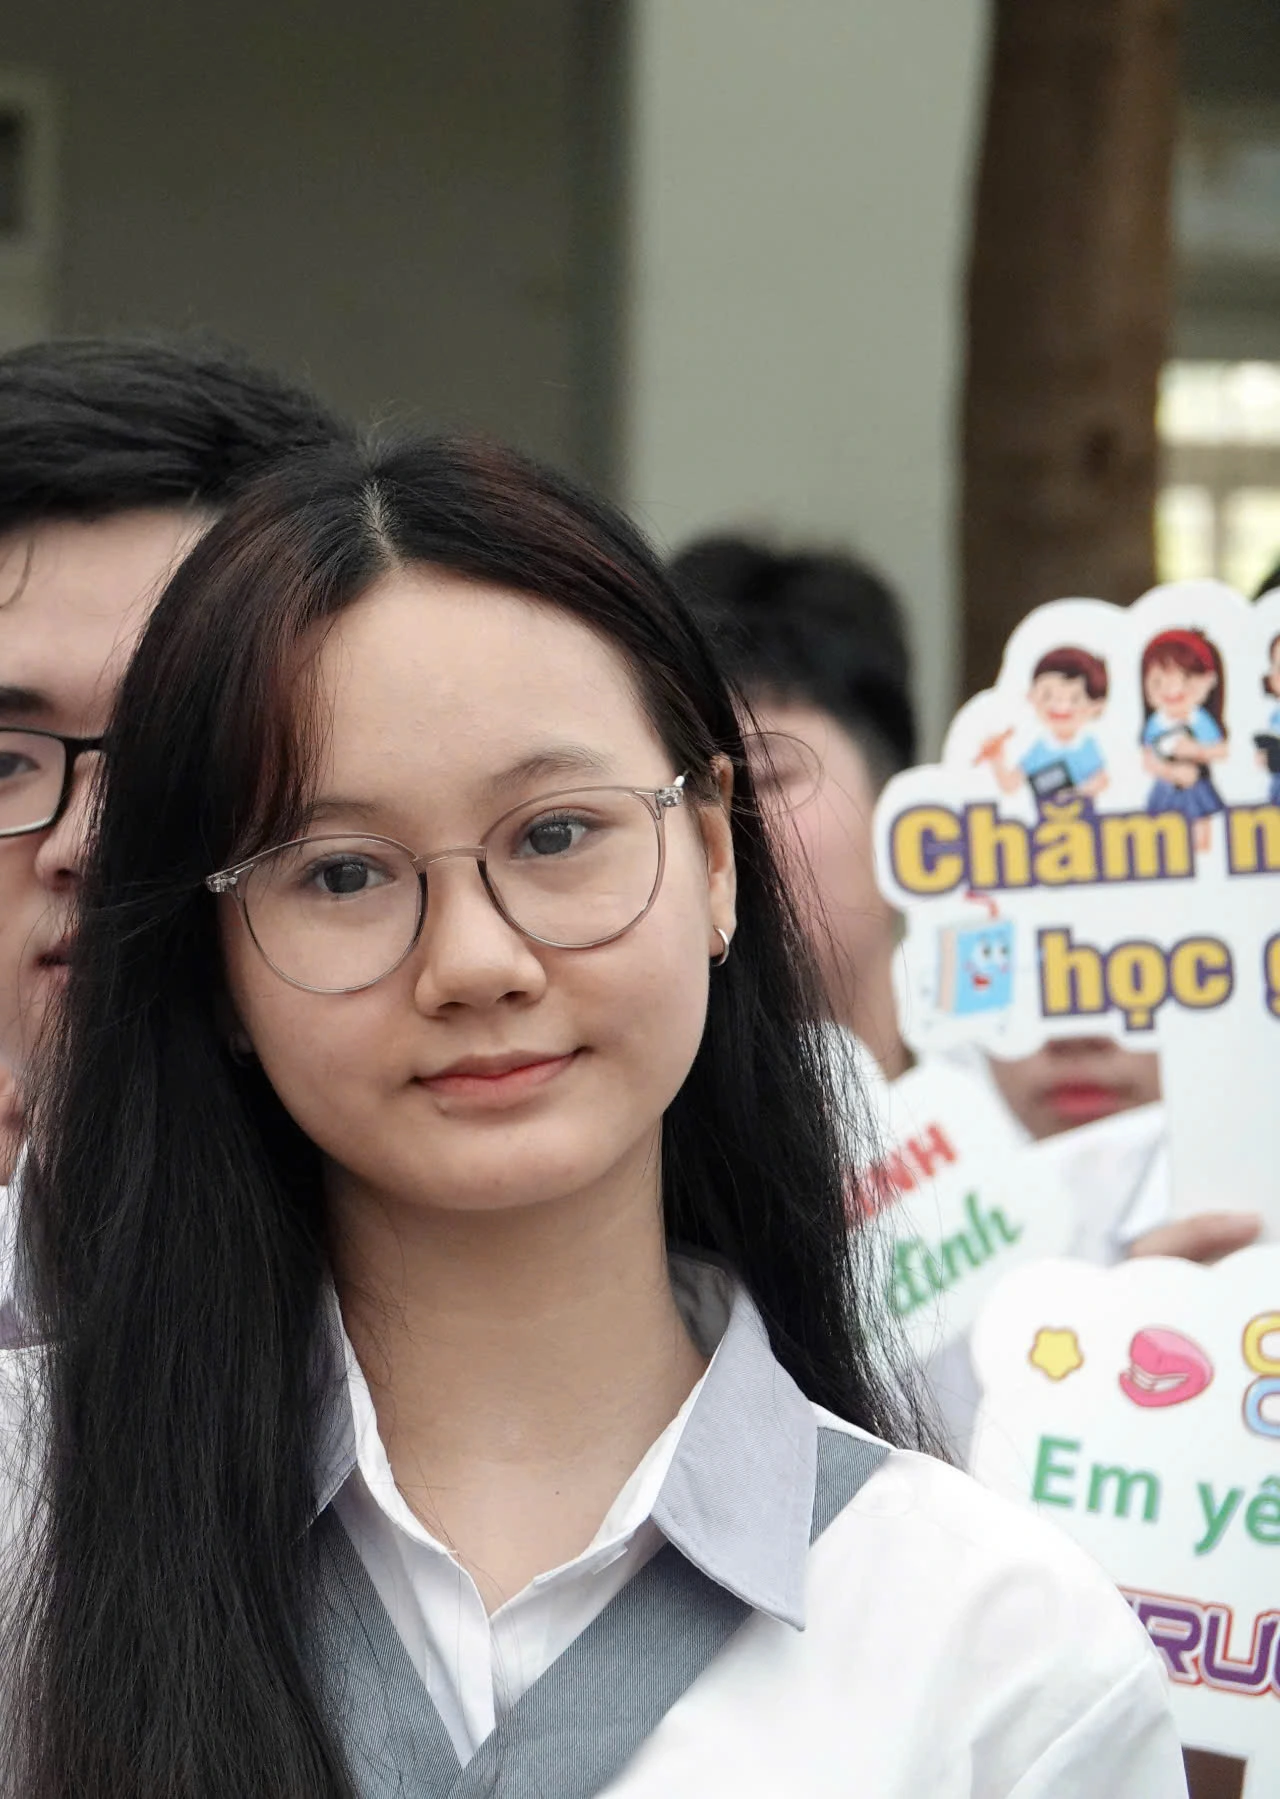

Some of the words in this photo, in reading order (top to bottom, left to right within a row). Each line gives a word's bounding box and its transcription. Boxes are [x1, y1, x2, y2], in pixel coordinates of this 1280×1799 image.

[890, 795, 1196, 895] Chăm
[1037, 927, 1234, 1031] học
[1032, 1434, 1160, 1524] Em
